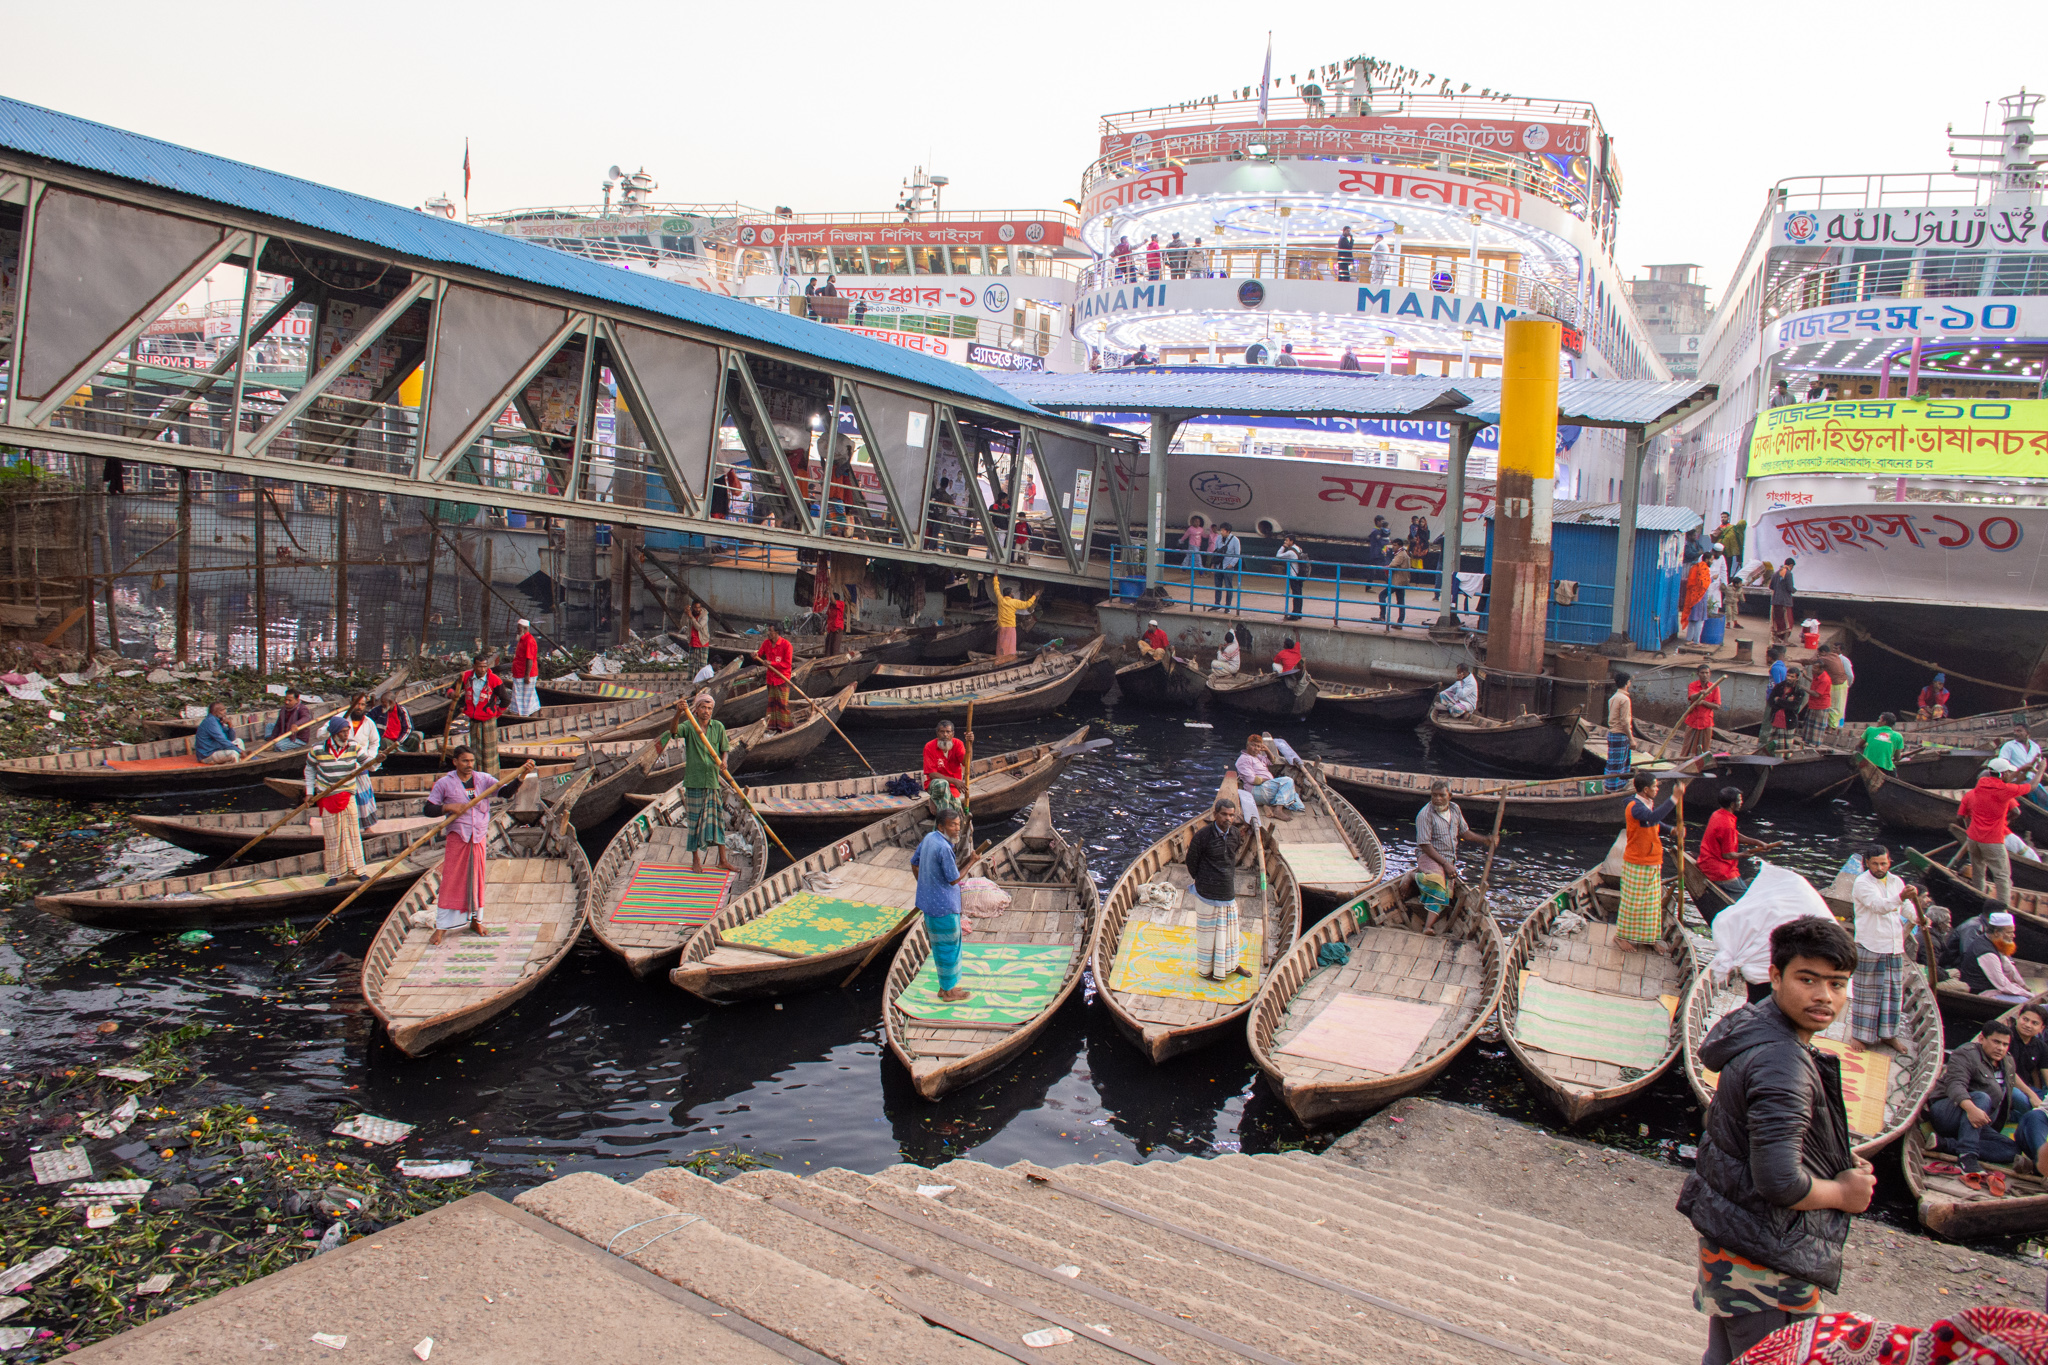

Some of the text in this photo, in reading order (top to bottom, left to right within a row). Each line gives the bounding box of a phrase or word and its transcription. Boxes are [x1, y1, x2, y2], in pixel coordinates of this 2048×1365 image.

[1424, 122, 1516, 147] লিমিটেড
[1084, 166, 1188, 221] মানামী
[1338, 169, 1523, 219] মানামী
[830, 229, 876, 243] নিজাম
[881, 228, 922, 242] শিপিং
[1077, 284, 1167, 322] MANAMI
[137, 354, 191, 368] SUROVI-8
